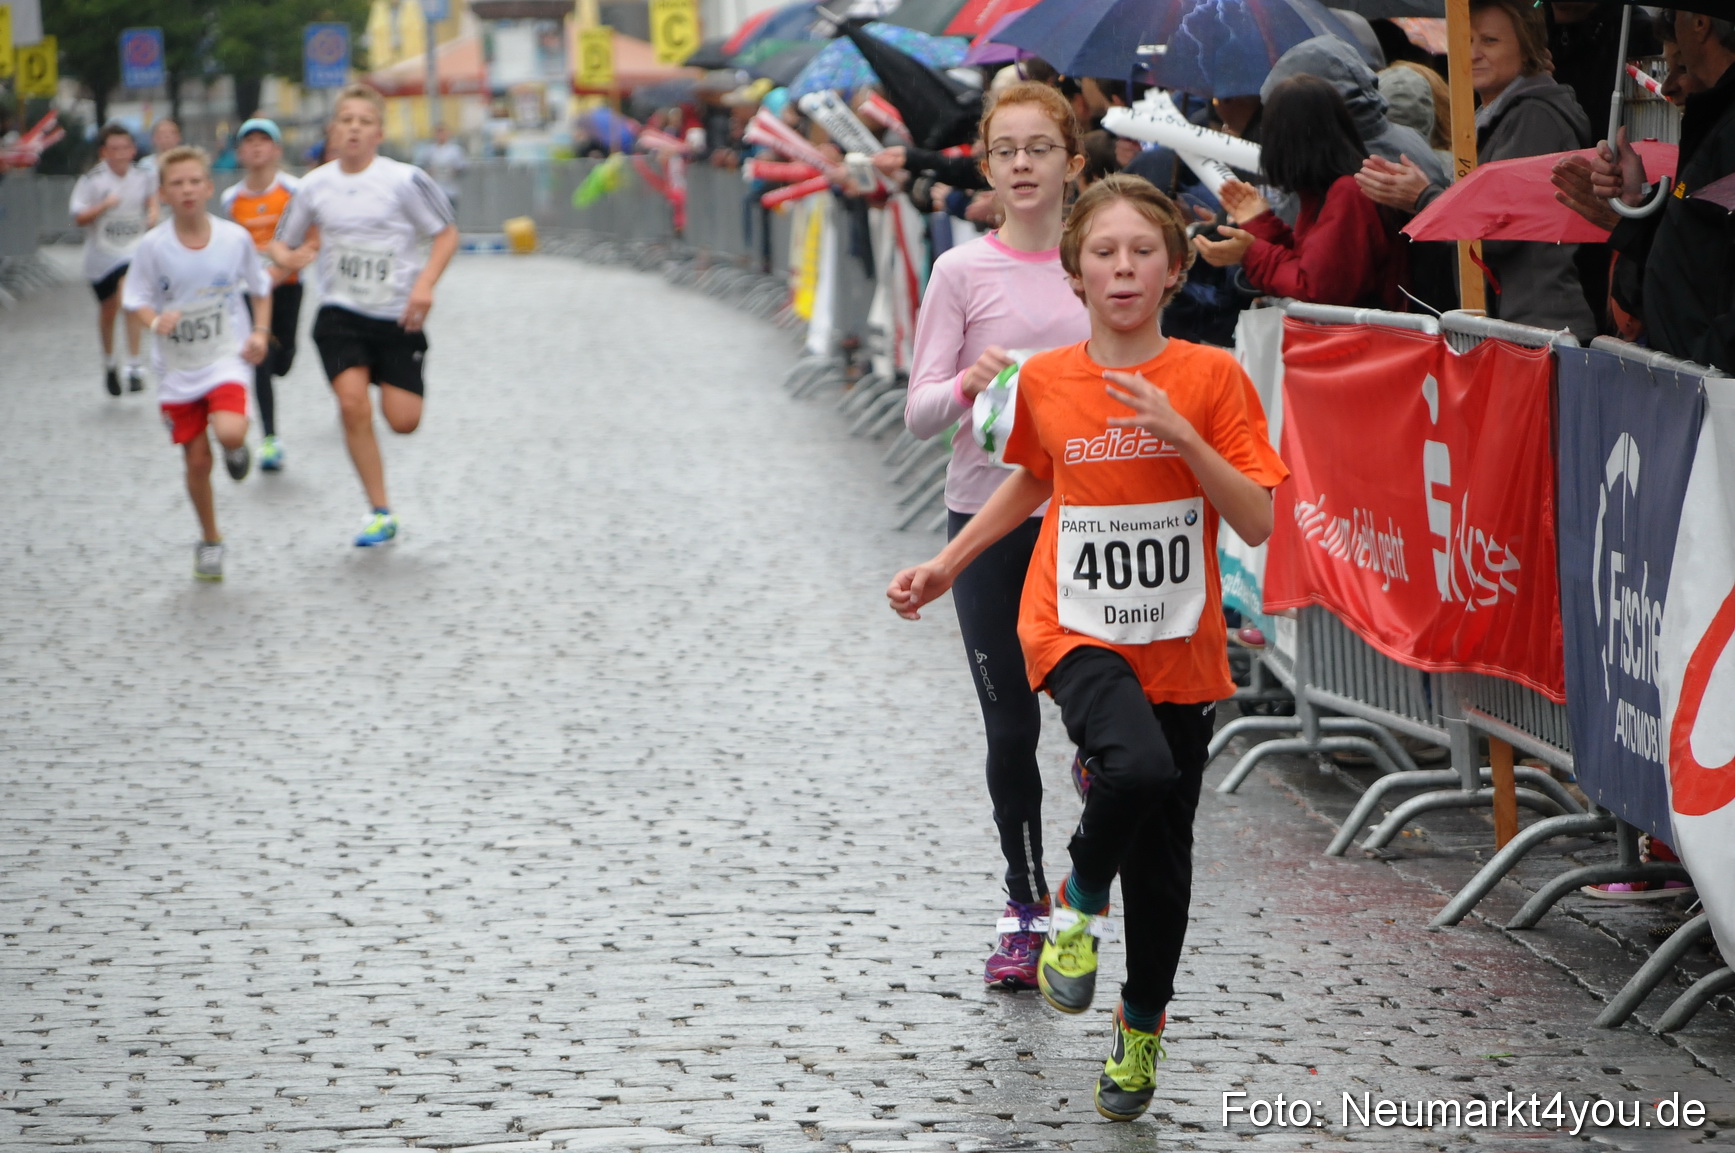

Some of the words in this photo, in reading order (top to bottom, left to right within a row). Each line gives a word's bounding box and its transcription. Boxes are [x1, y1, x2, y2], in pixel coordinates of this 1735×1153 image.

[662, 12, 691, 51] C
[337, 254, 388, 281] 4019
[1061, 519, 1106, 533] PARTL
[1110, 515, 1180, 532] Neumarkt
[1073, 534, 1190, 590] 4000
[1104, 602, 1165, 625] Daniel
[980, 664, 998, 702] odlo
